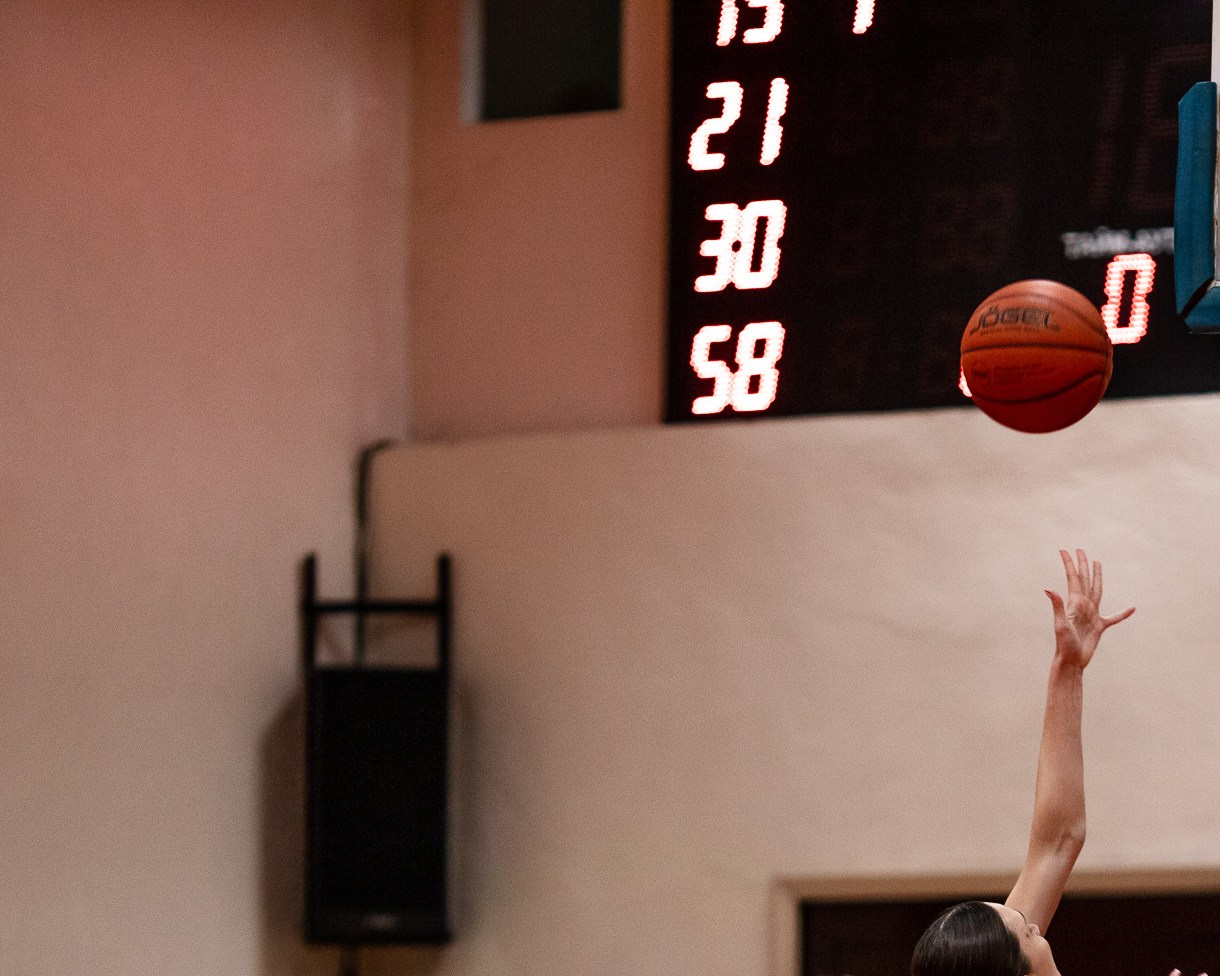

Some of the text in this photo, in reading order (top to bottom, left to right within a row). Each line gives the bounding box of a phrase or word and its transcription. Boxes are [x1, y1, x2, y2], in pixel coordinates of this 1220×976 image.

[688, 77, 790, 171] 21
[694, 200, 787, 292] 30
[1101, 251, 1157, 344] 0
[690, 321, 786, 415] 58
